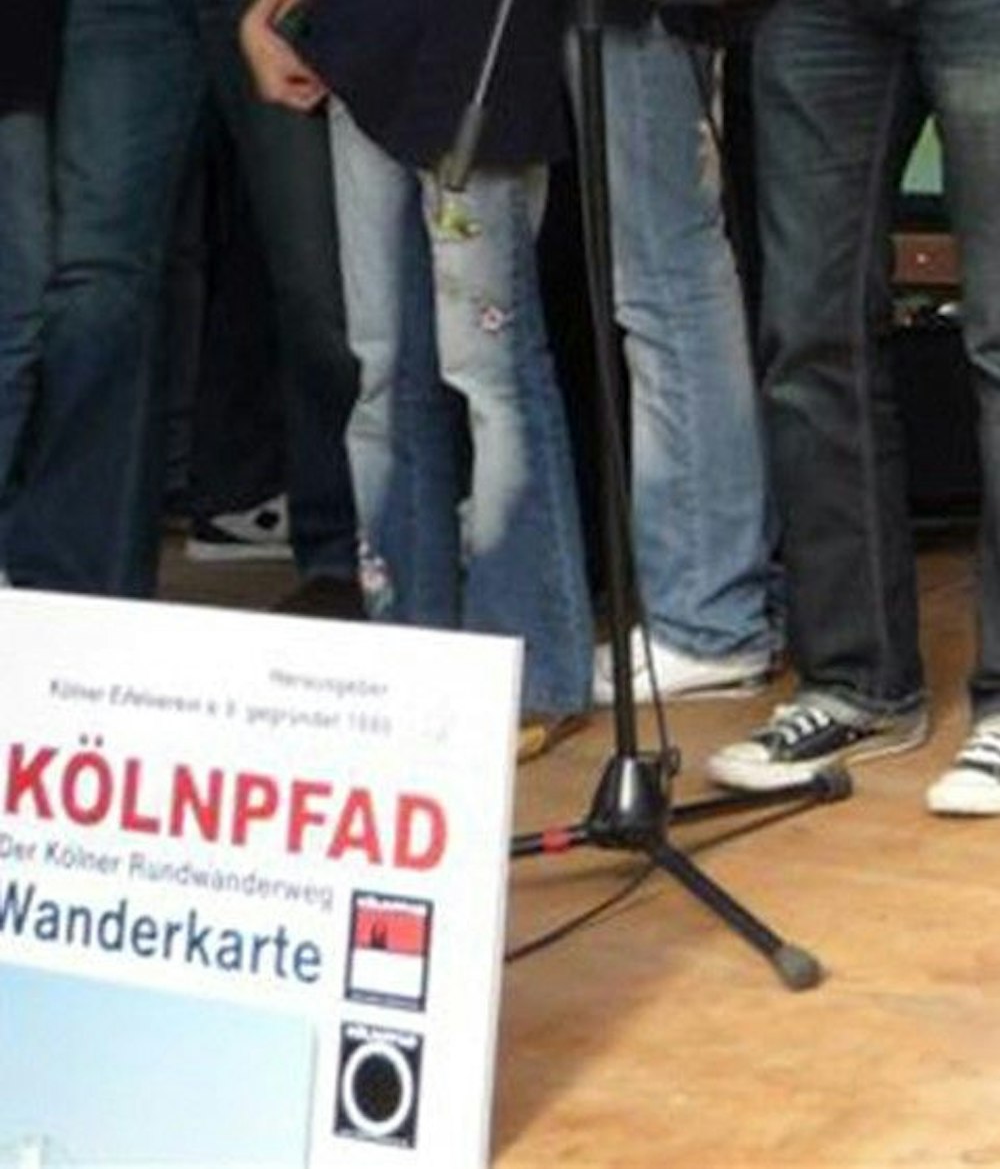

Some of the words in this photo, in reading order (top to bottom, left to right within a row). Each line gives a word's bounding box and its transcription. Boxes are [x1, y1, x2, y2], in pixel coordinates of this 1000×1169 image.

[4, 734, 450, 872] KÖLNPFAD
[0, 832, 36, 861] Der
[129, 851, 334, 912] Rundwanderweg
[0, 879, 324, 984] Wanderkarte
